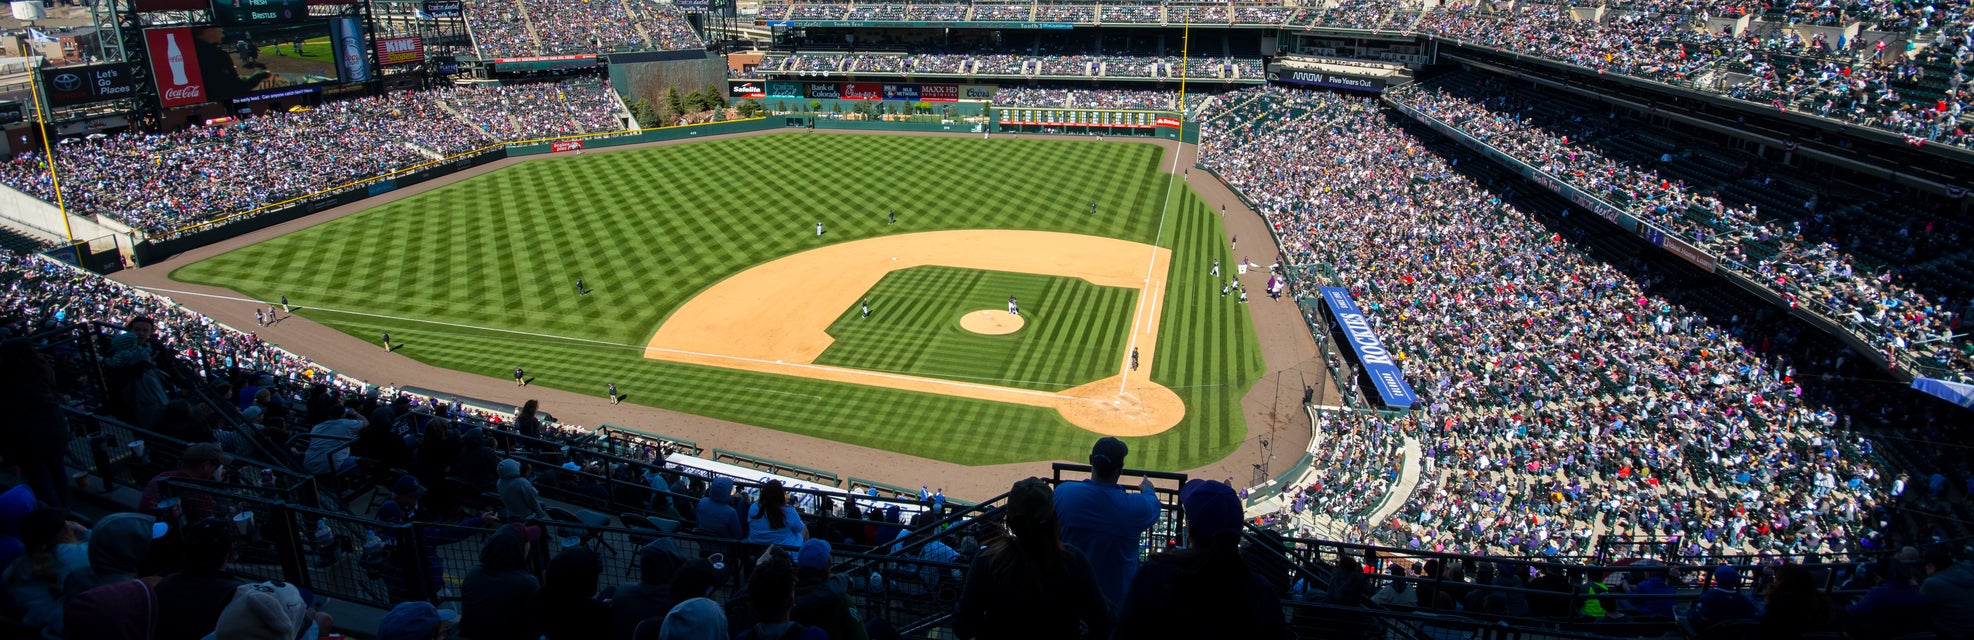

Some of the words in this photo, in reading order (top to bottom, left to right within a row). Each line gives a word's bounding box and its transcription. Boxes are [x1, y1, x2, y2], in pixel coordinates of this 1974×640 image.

[385, 39, 415, 52] KING
[96, 70, 118, 79] Let's
[1292, 71, 1323, 83] ARROW
[1329, 76, 1342, 84] Five
[1342, 78, 1359, 86] Years
[1360, 79, 1371, 87] Out
[98, 79, 111, 87] Go
[921, 85, 944, 93] MAXX
[100, 85, 130, 95] Places
[165, 86, 200, 101] Coca-Cola
[967, 87, 990, 97] Coors
[1532, 171, 1548, 188] Tooth
[1594, 201, 1620, 225] dental
[1340, 313, 1394, 366] ROCKIES
